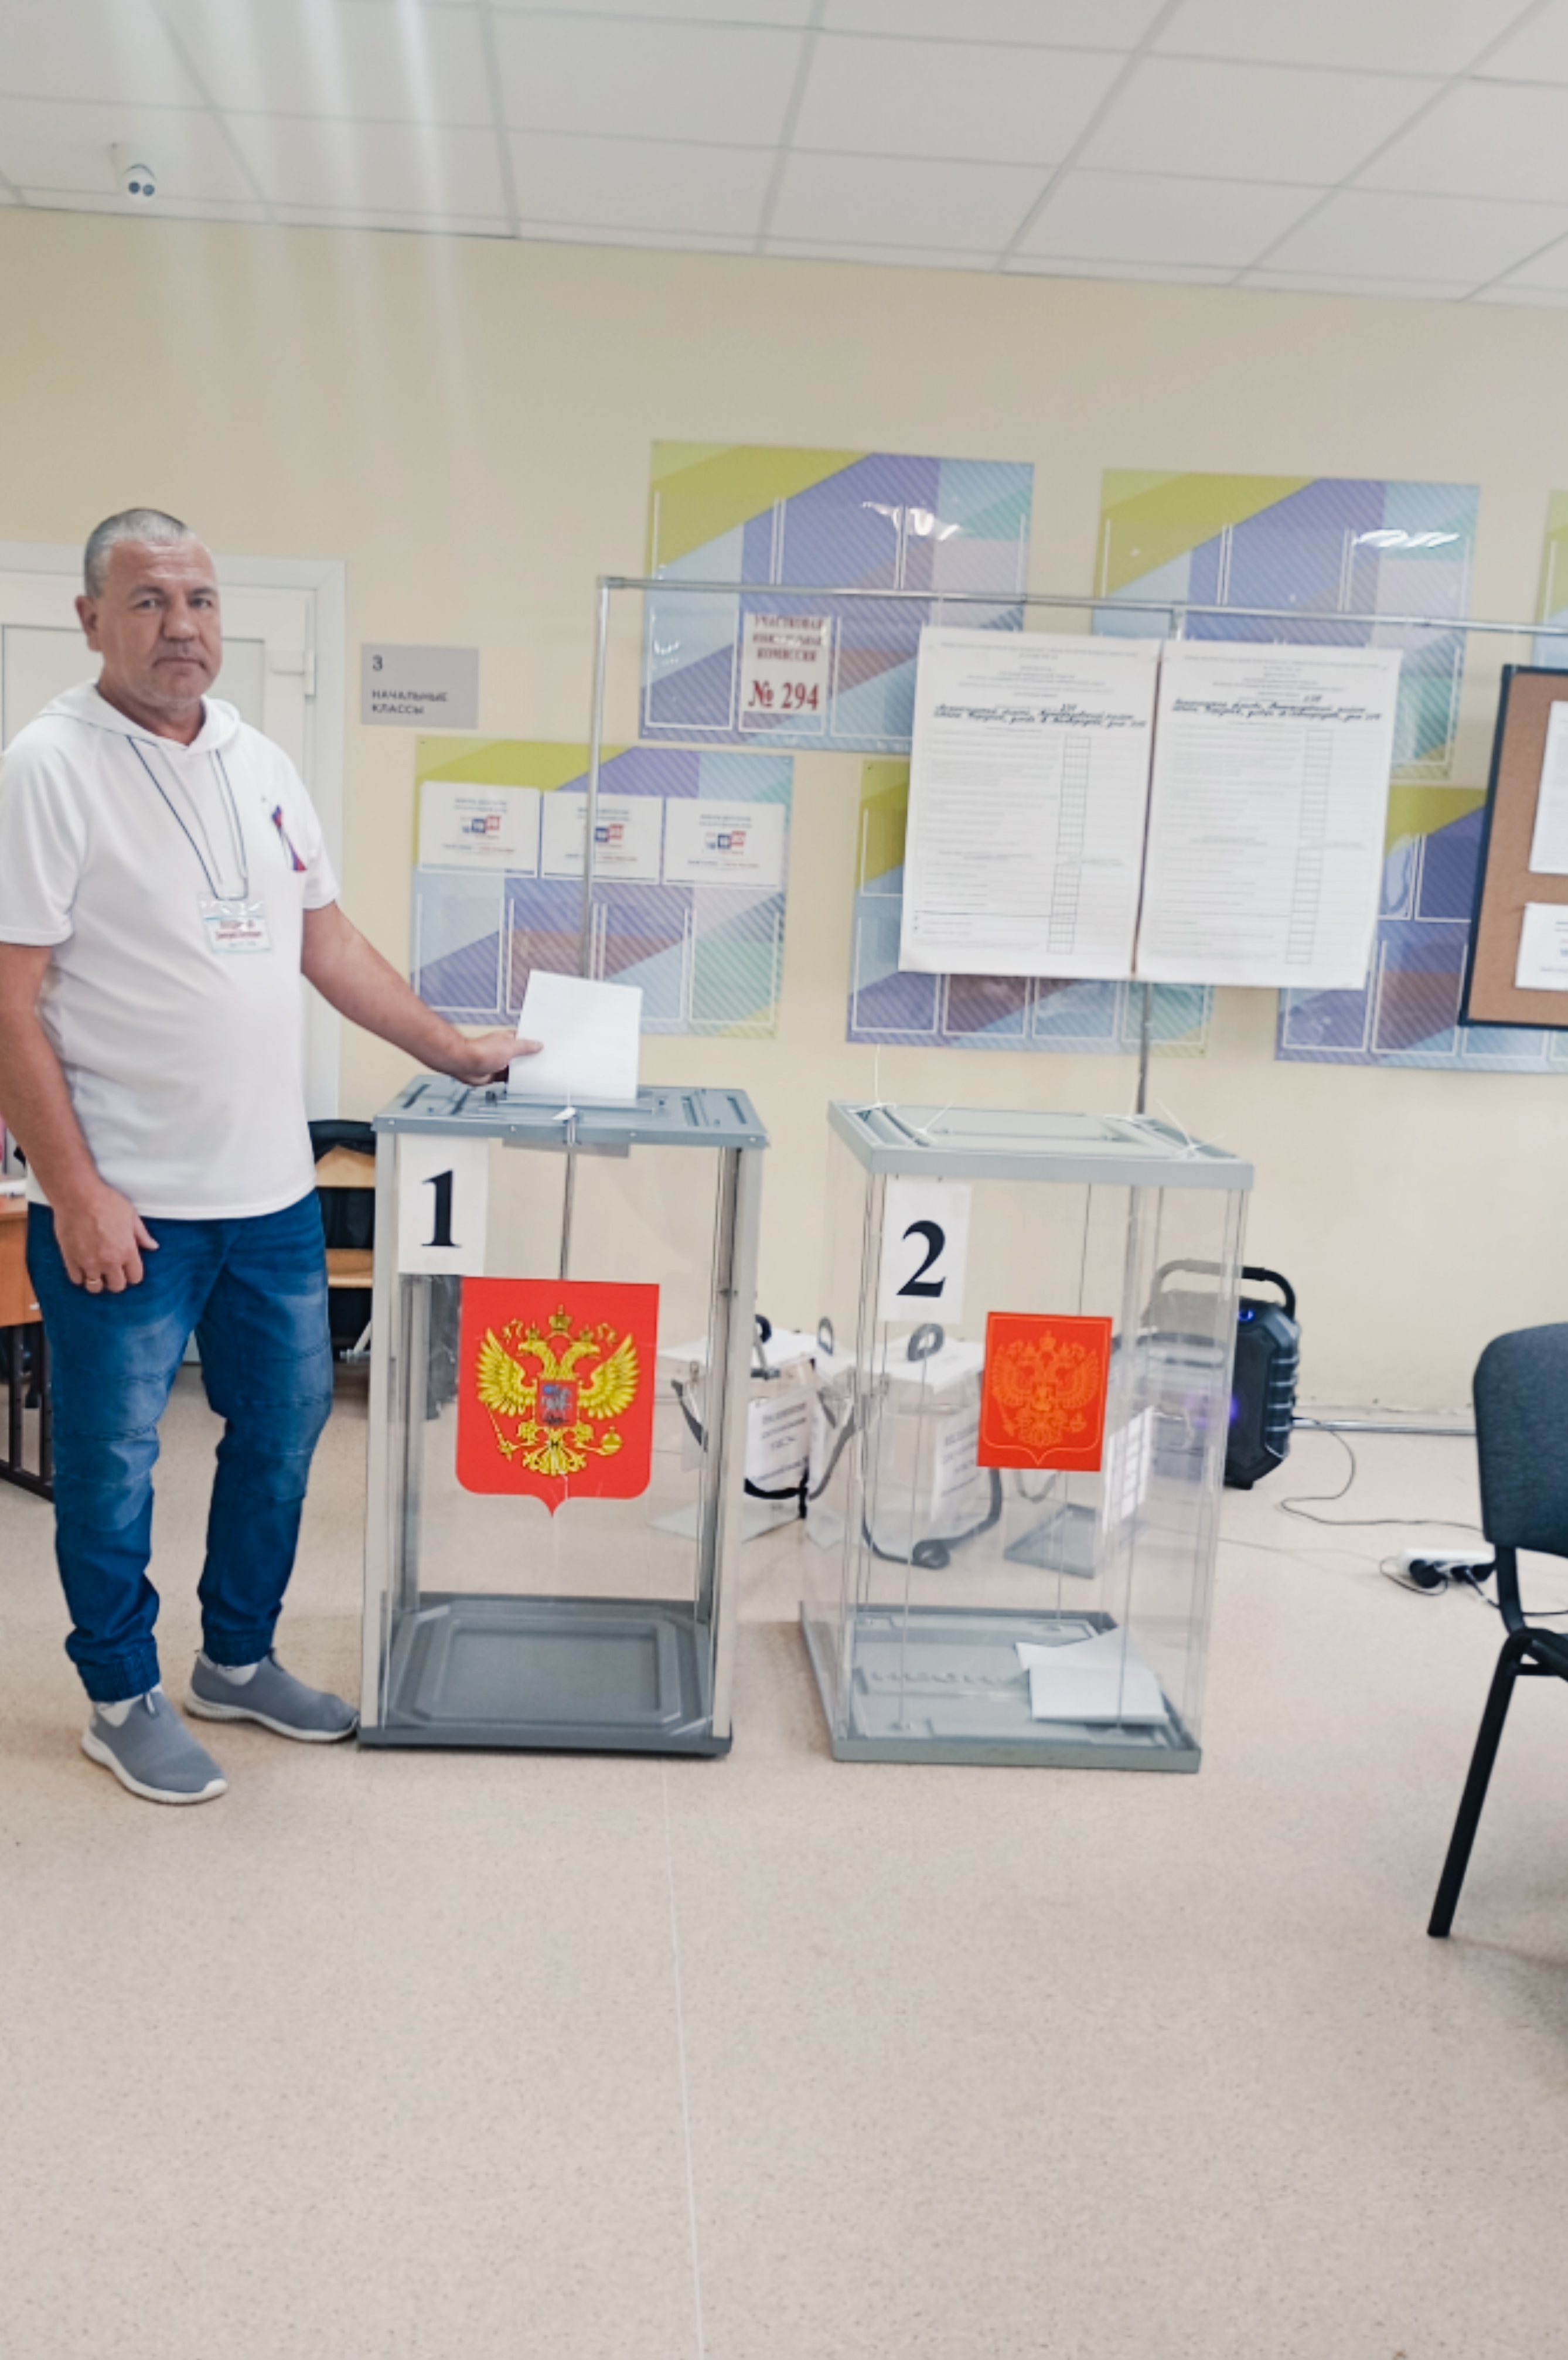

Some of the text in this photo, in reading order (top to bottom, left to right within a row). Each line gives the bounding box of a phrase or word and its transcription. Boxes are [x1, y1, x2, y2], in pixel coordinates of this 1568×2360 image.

[372, 654, 383, 672] 3
[371, 689, 448, 703] НАЧАЛЬНЫЕ
[748, 680, 819, 711] № 294
[371, 703, 425, 716] КЛАССЫ
[421, 1169, 461, 1248] 1
[897, 1219, 947, 1298] 2
